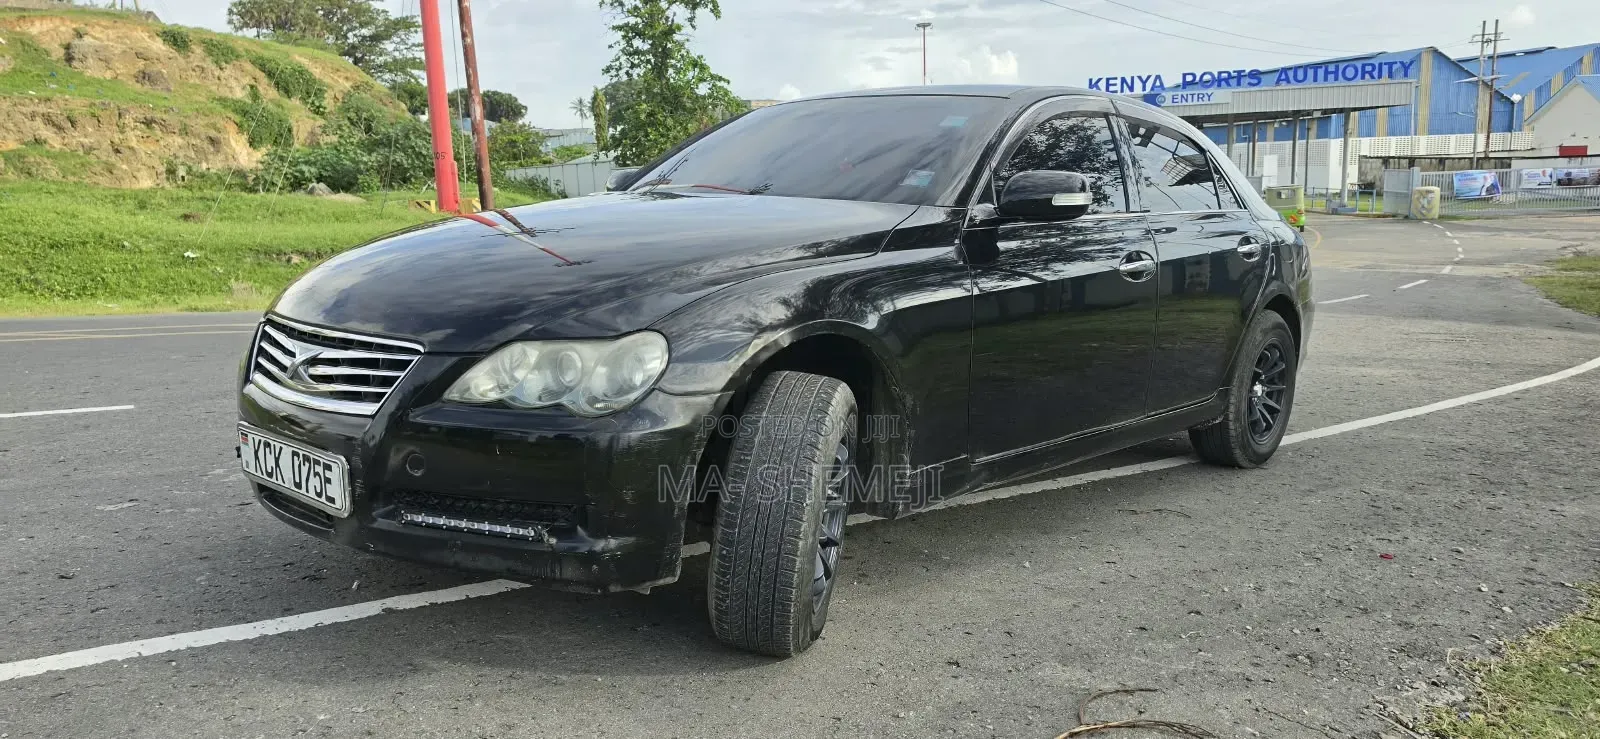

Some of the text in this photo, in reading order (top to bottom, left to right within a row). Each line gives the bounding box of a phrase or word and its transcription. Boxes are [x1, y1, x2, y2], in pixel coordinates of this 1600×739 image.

[1087, 59, 1415, 94] KENYA PORTS AUTHORITY
[1171, 92, 1214, 103] ENTRY
[252, 437, 336, 505] KCK 075E
